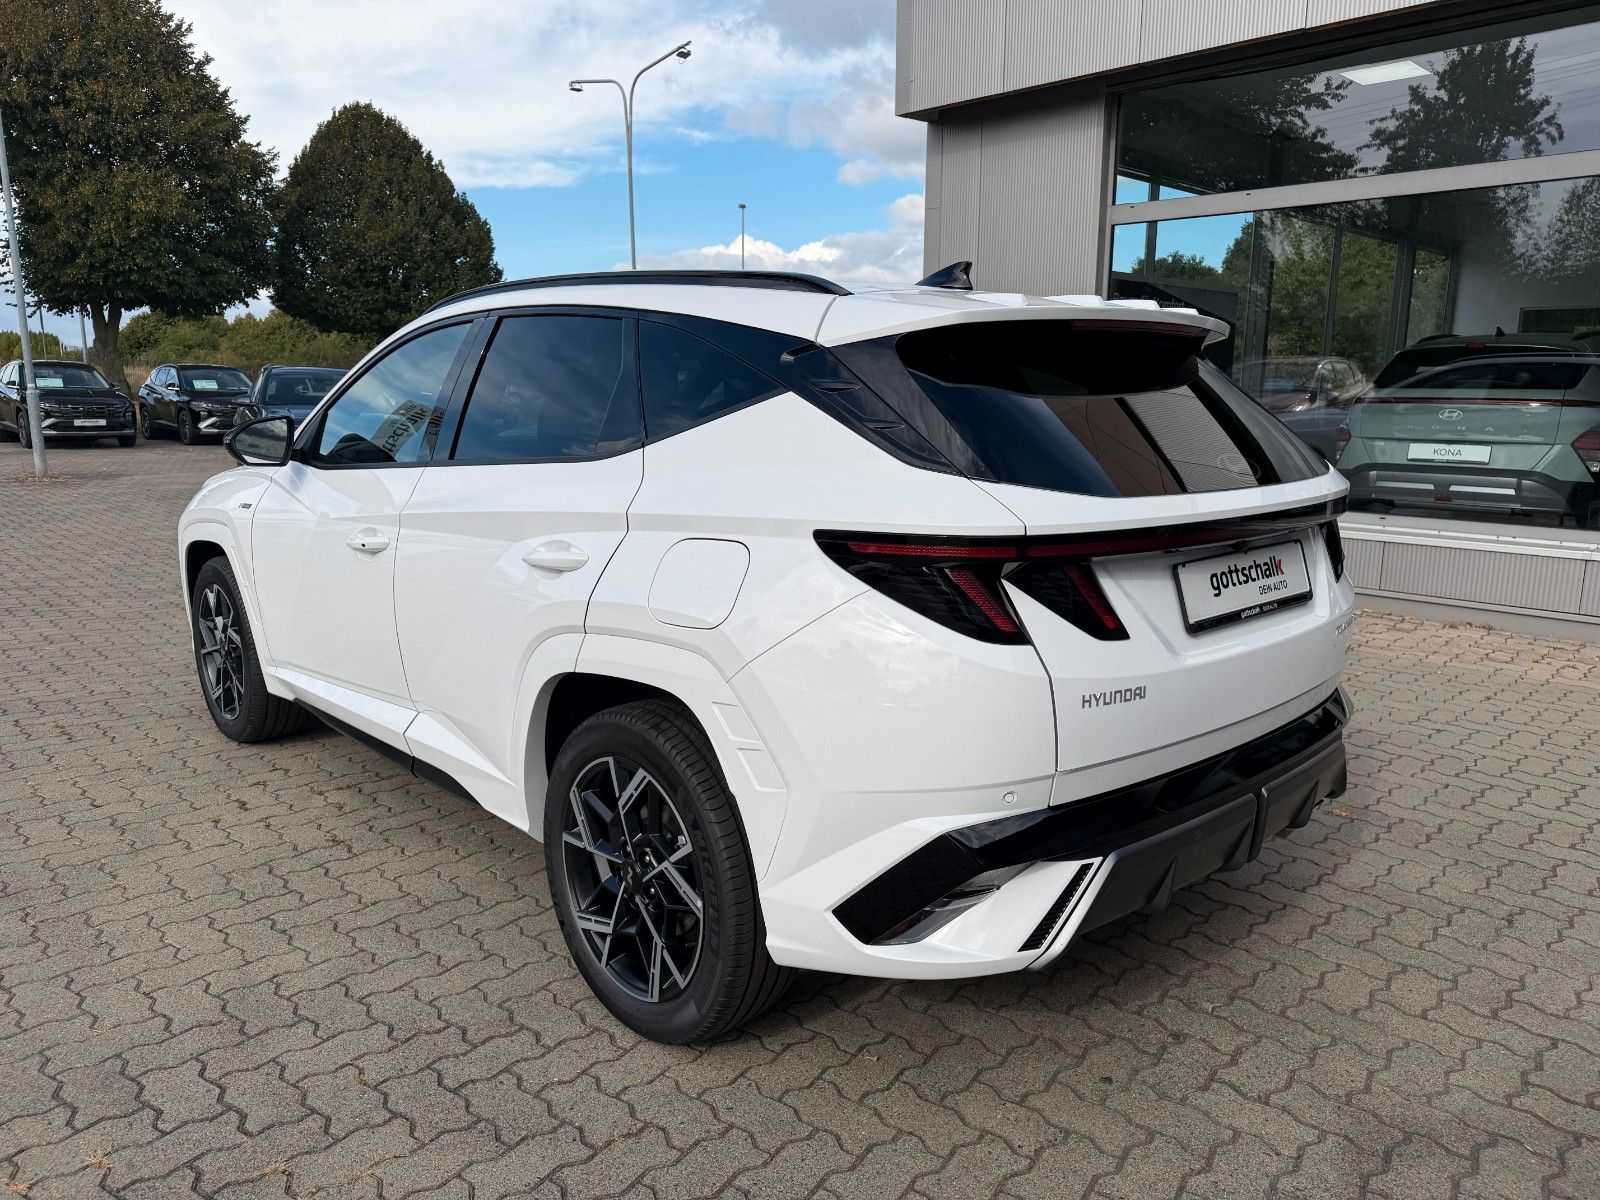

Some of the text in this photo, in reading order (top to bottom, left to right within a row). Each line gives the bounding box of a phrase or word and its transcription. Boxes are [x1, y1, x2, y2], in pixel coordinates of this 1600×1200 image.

[1433, 448, 1462, 457] KONA
[1209, 556, 1285, 598] gottschalk
[1258, 580, 1288, 595] DEIN AUTO
[1081, 685, 1147, 709] HYUNDAI
